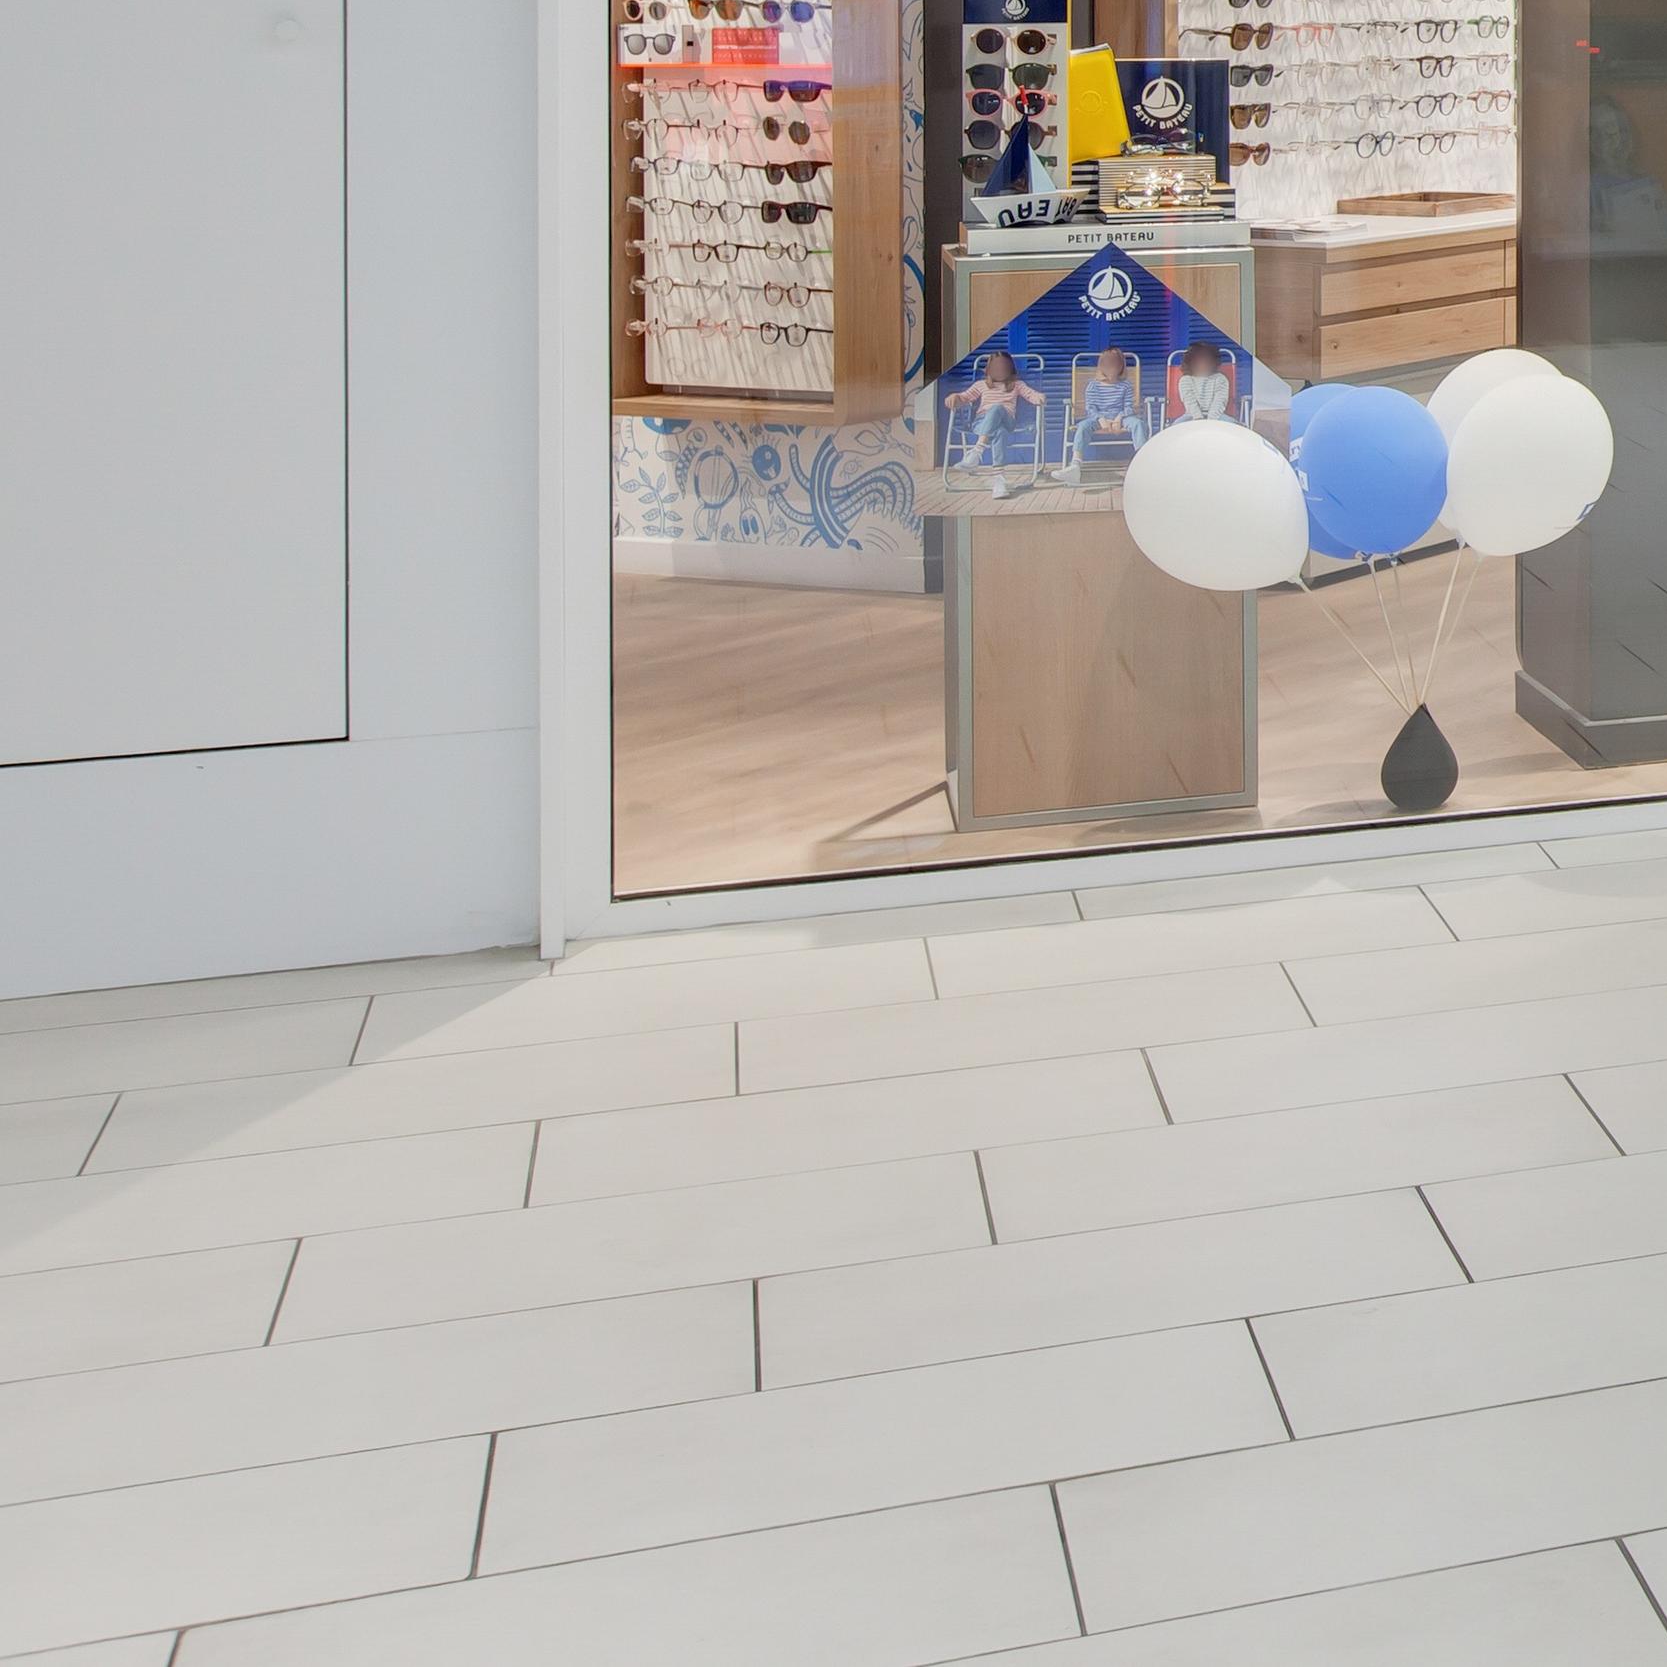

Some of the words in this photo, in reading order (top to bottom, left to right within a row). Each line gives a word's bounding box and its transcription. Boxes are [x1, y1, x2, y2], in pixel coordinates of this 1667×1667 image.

[1132, 104, 1157, 130] PETIT
[1159, 103, 1194, 130] BATEAU
[1068, 231, 1102, 243] PETIT
[1105, 230, 1154, 243] BATEAU
[1078, 295, 1103, 321] PETIT
[1105, 294, 1142, 322] BATEAU
